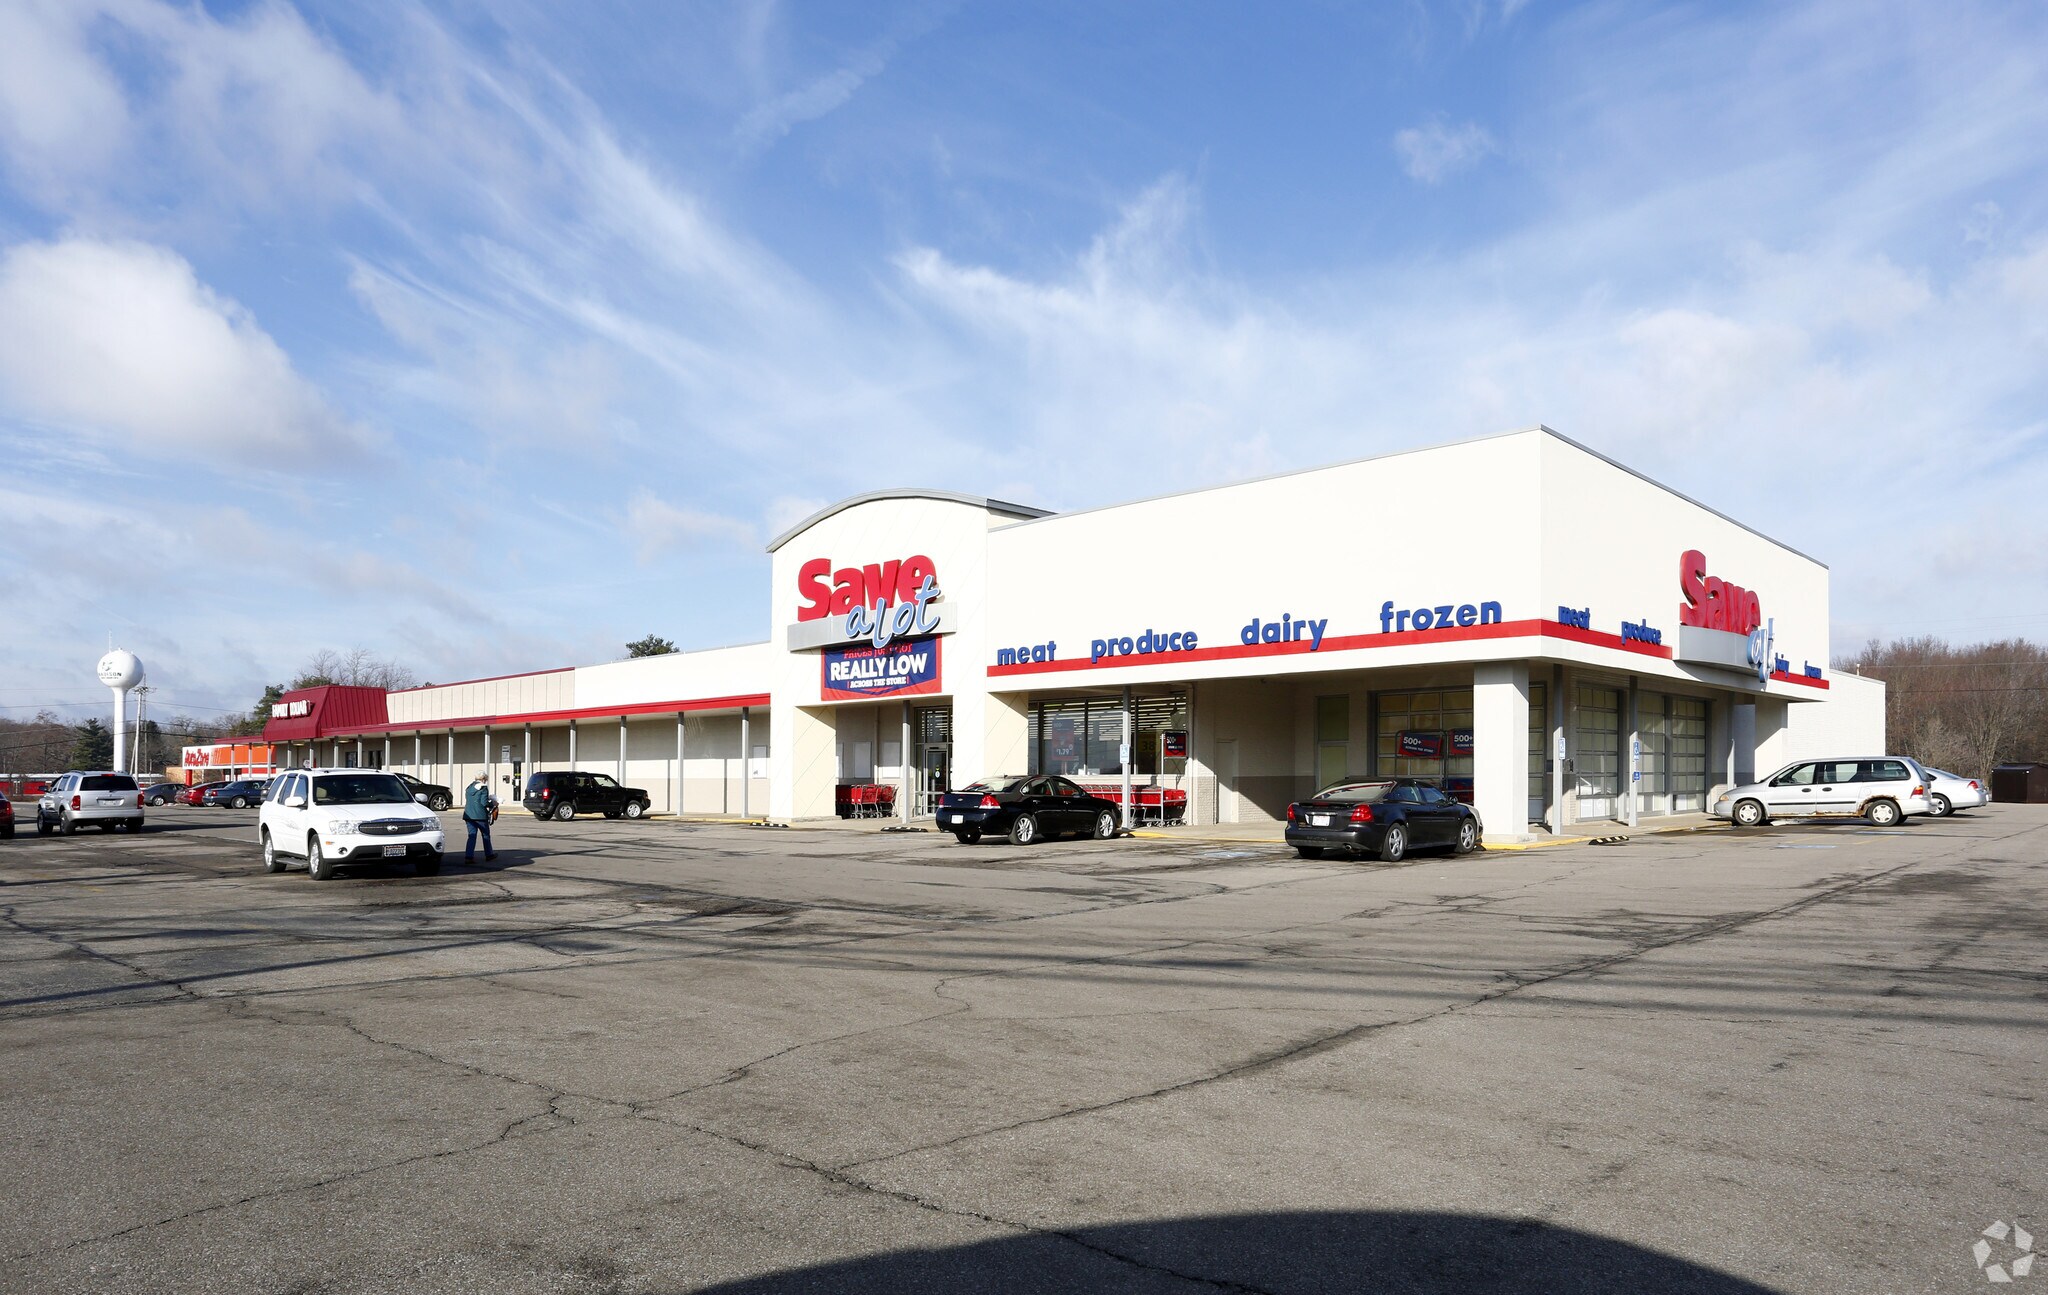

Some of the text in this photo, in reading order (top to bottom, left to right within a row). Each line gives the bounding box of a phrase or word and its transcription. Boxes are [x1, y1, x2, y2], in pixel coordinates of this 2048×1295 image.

[798, 555, 938, 622] Save
[1680, 550, 1761, 636] Save
[997, 601, 1502, 667] meat produce dairy frozen
[1558, 606, 1661, 646] meat produce
[831, 653, 928, 681] REALLY LOW
[850, 676, 907, 689] ACROSS THE STORE
[1403, 736, 1422, 746] 500+
